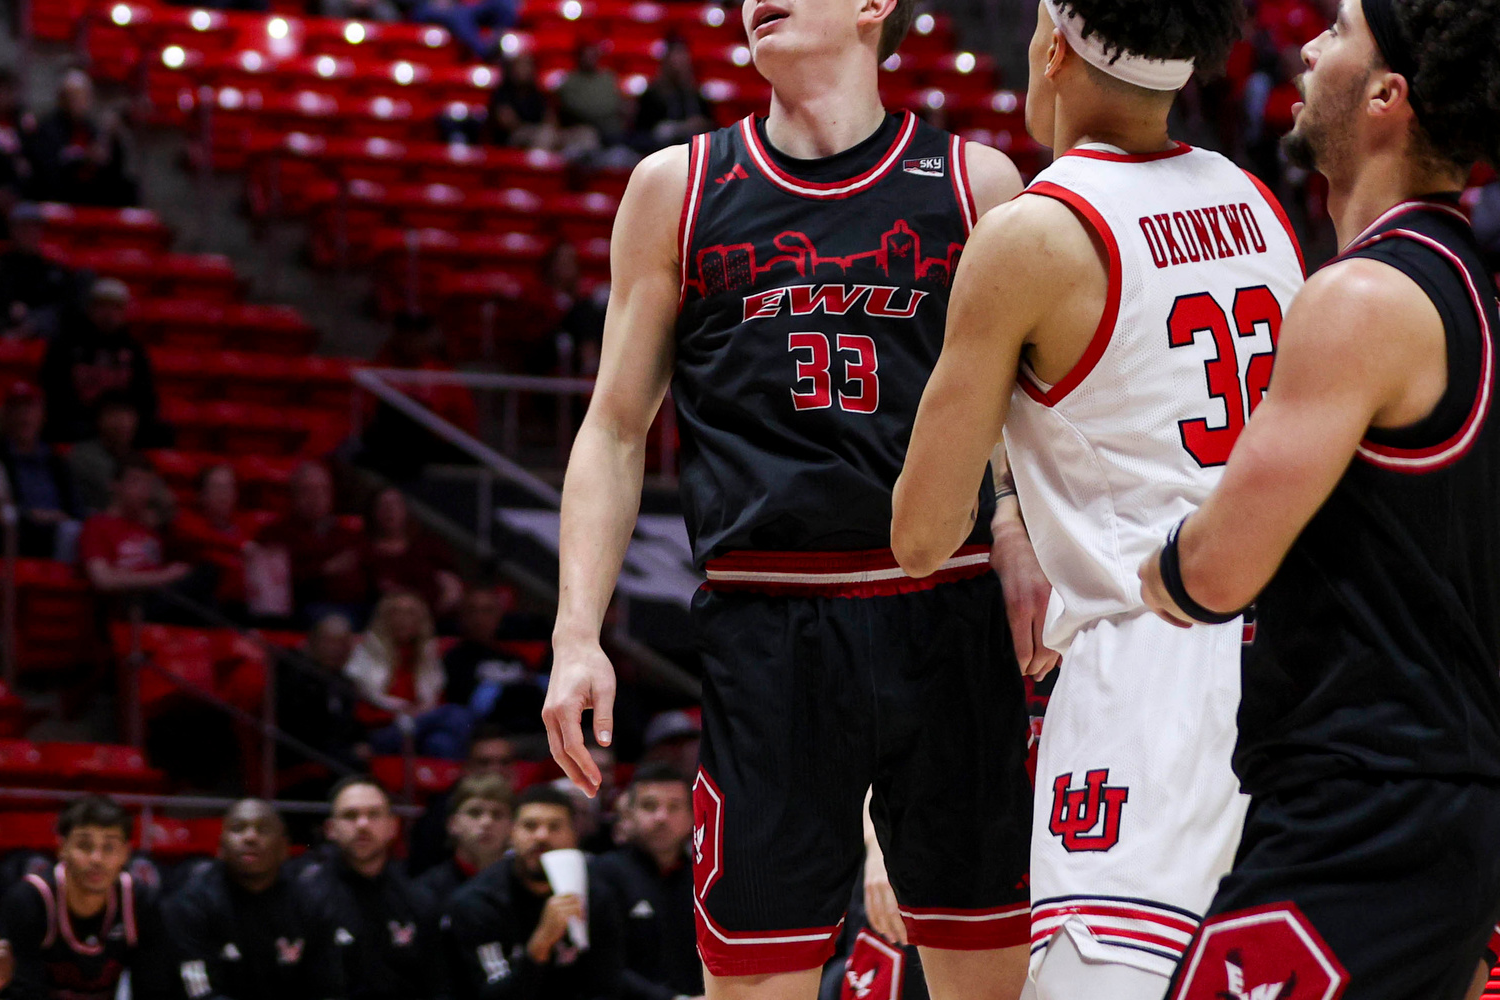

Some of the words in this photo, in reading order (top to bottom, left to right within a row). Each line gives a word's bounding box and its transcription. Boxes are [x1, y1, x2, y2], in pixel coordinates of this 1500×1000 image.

[919, 158, 942, 170] SKY
[1138, 202, 1268, 269] OKONKWO
[741, 283, 930, 324] EWU
[787, 331, 880, 414] 33
